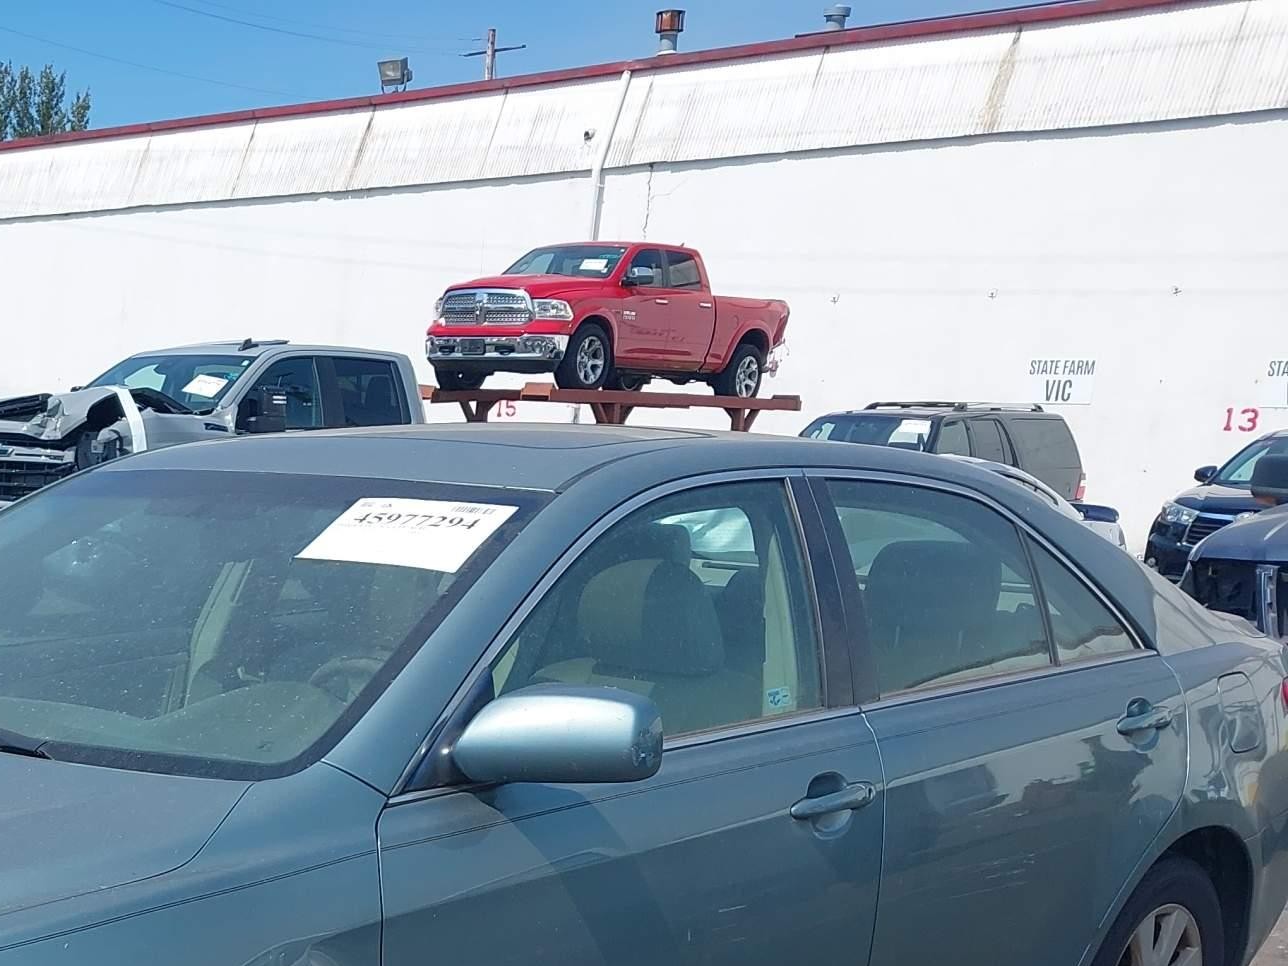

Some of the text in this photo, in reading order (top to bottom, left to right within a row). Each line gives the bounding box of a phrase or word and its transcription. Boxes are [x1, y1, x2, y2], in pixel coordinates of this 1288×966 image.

[1029, 359, 1096, 376] STATE FARM
[1045, 379, 1073, 402] VIC
[496, 400, 516, 418] 15
[1223, 407, 1259, 432] 13
[353, 512, 481, 530] 45977294
